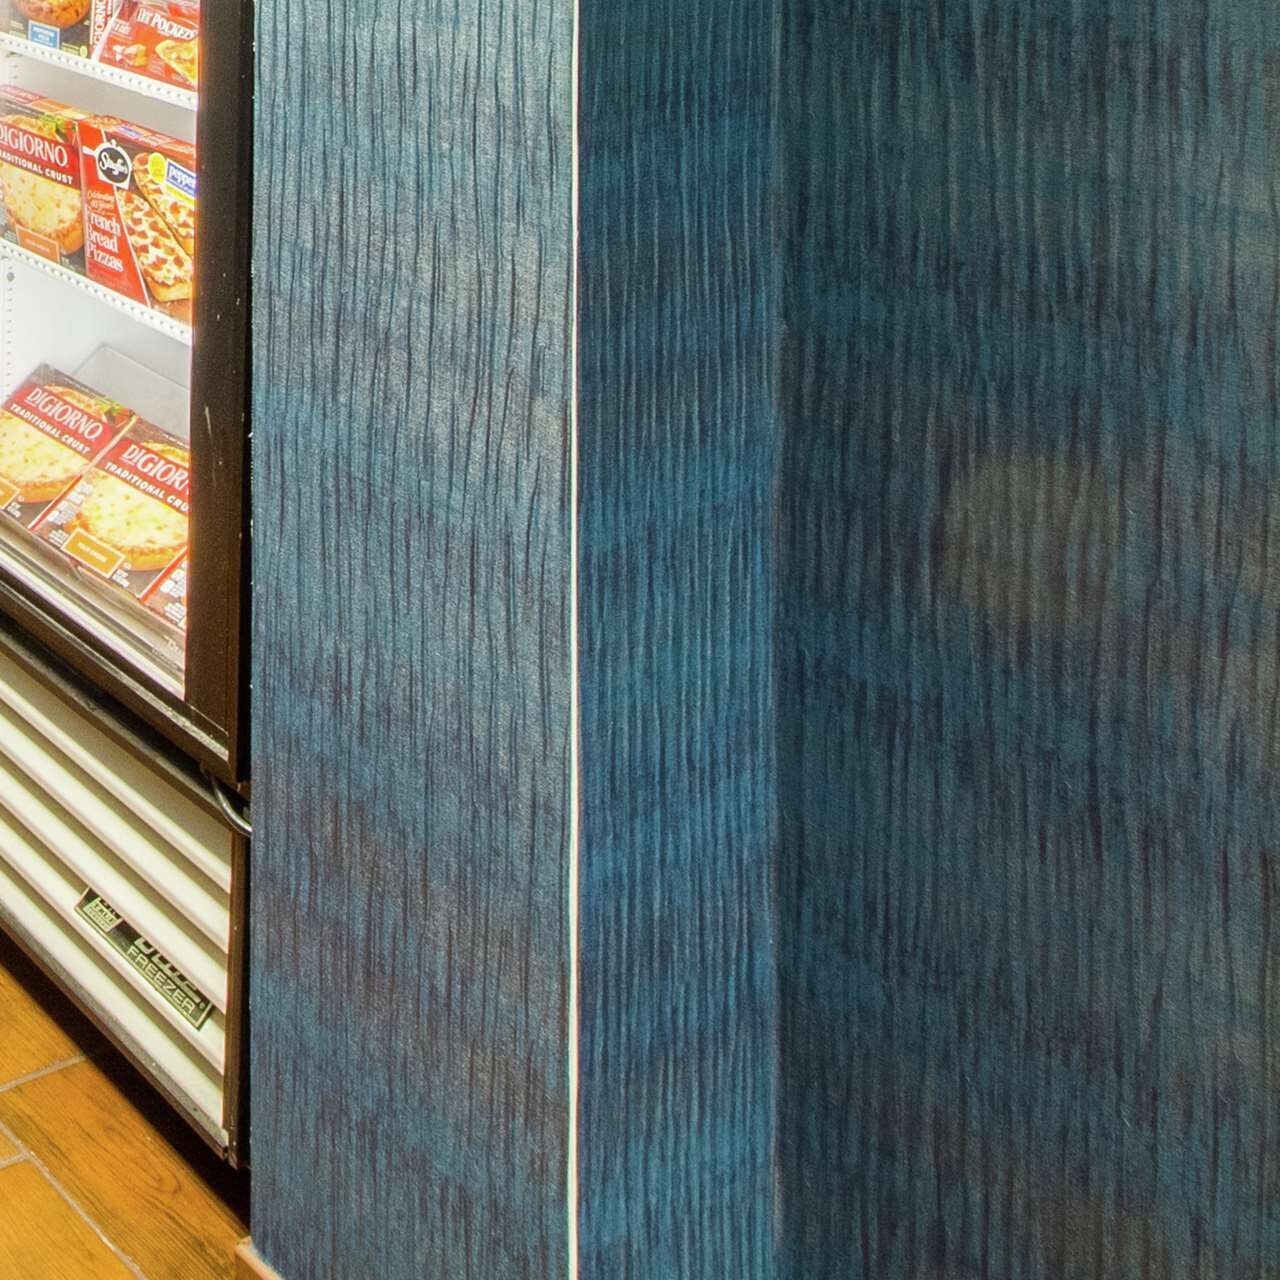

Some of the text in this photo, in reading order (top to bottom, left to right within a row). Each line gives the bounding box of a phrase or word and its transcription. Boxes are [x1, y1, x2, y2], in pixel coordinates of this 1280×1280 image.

[45, 167, 73, 185] CRUST
[9, 403, 91, 456] TRADITIONAL CRUST
[24, 387, 105, 443] DIGIORNO
[104, 462, 166, 499] TRADITIONAL
[127, 945, 196, 1015] FREEZER
